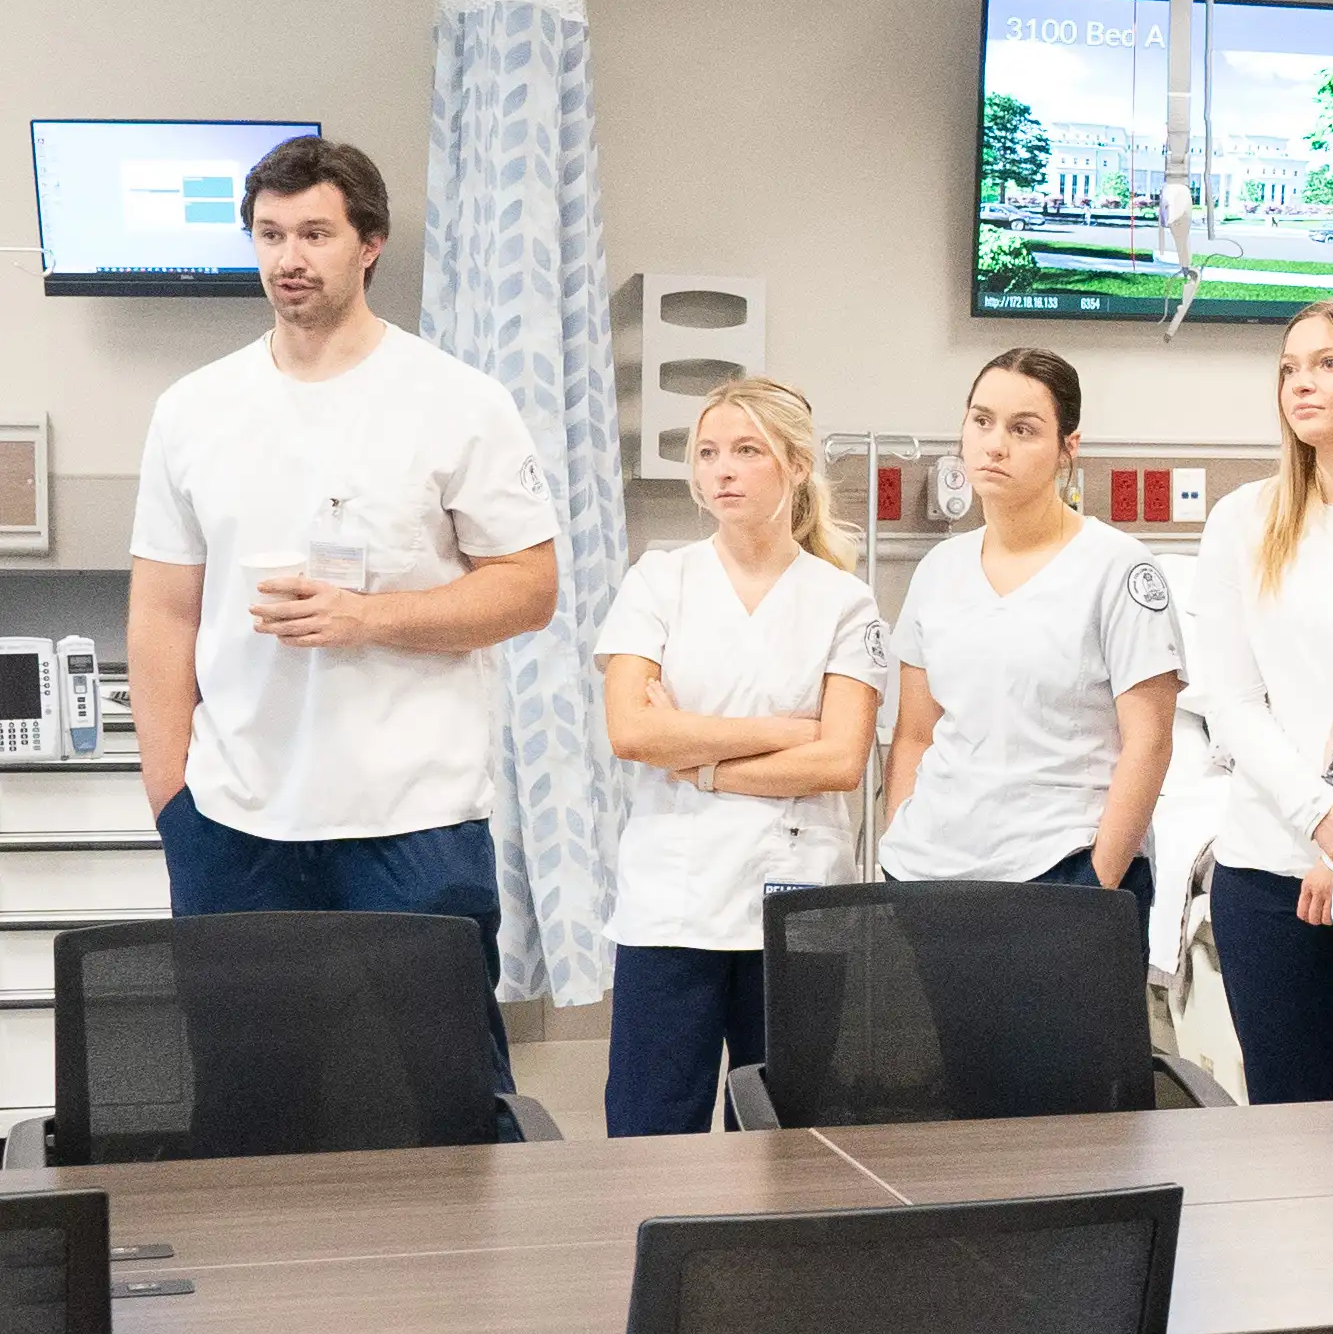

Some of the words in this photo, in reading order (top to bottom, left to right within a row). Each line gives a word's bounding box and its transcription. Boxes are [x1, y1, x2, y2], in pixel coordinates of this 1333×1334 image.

[1006, 17, 1078, 45] 3100
[1085, 21, 1136, 48] Bed
[1144, 24, 1165, 49] A
